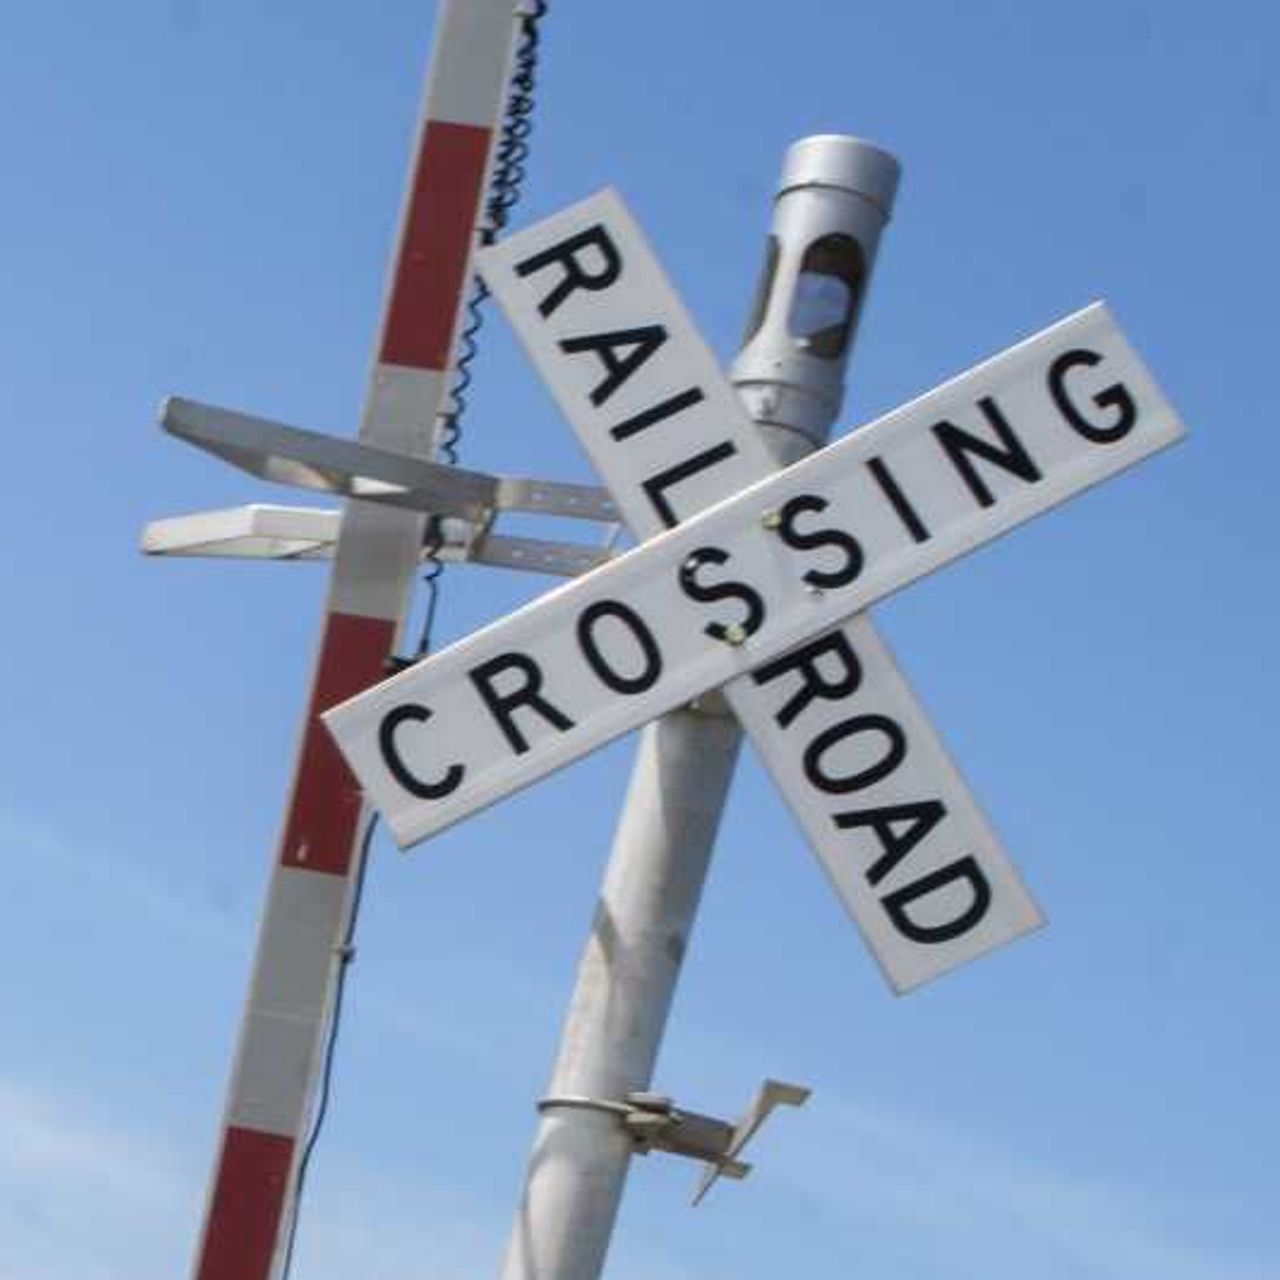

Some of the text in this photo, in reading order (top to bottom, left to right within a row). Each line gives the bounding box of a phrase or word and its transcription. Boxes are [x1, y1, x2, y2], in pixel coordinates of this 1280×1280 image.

[376, 347, 1139, 803] CROSSING
[513, 223, 993, 946] RAIL ROAD
